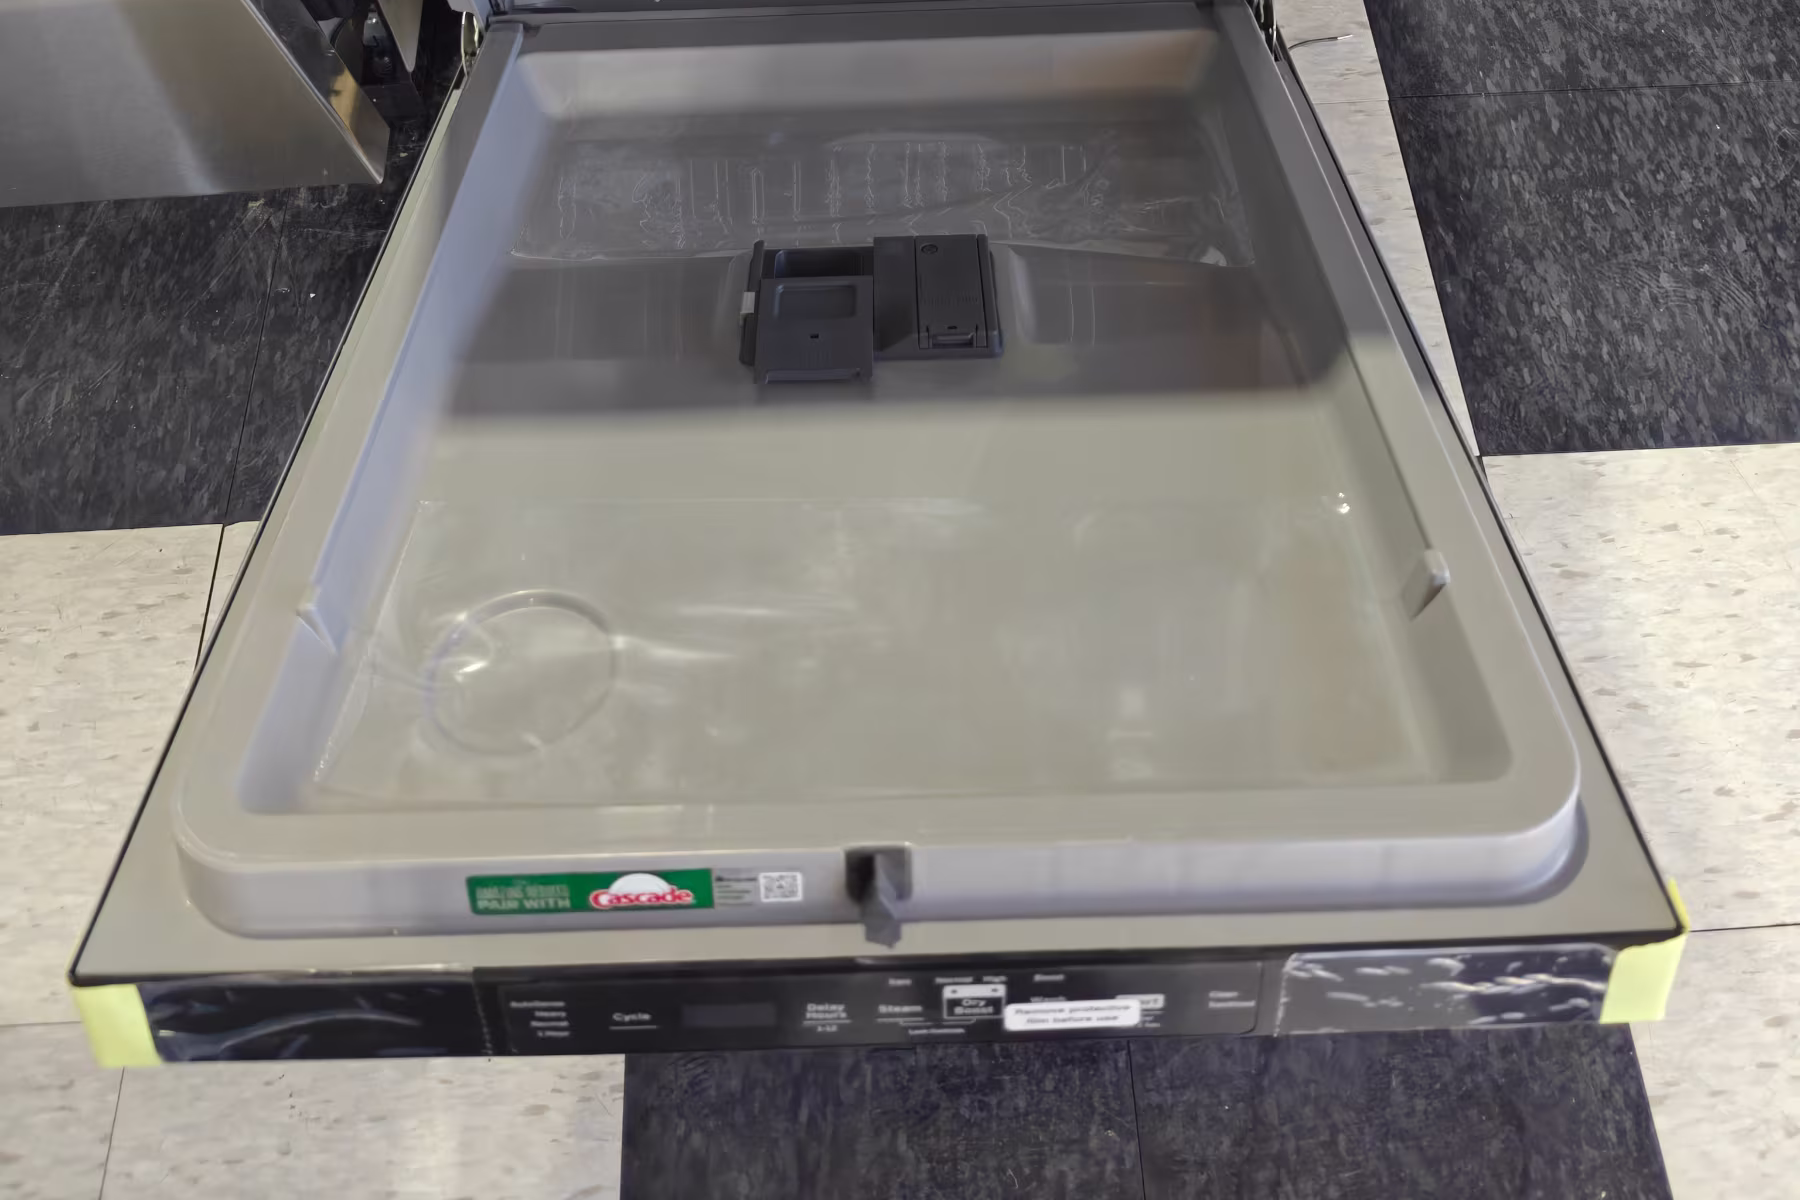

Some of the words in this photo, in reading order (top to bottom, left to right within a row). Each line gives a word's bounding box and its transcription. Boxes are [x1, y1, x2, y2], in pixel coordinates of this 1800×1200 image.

[591, 886, 692, 909] Cascade
[523, 897, 570, 909] WITH
[806, 1003, 846, 1013] Delay
[962, 999, 987, 1007] Dry
[878, 1004, 923, 1013] Steam
[953, 1006, 994, 1015] Boost
[1015, 1007, 1065, 1015] Remove
[1069, 1005, 1131, 1014] protective
[612, 1012, 651, 1022] Cycle
[1053, 1015, 1092, 1023] before
